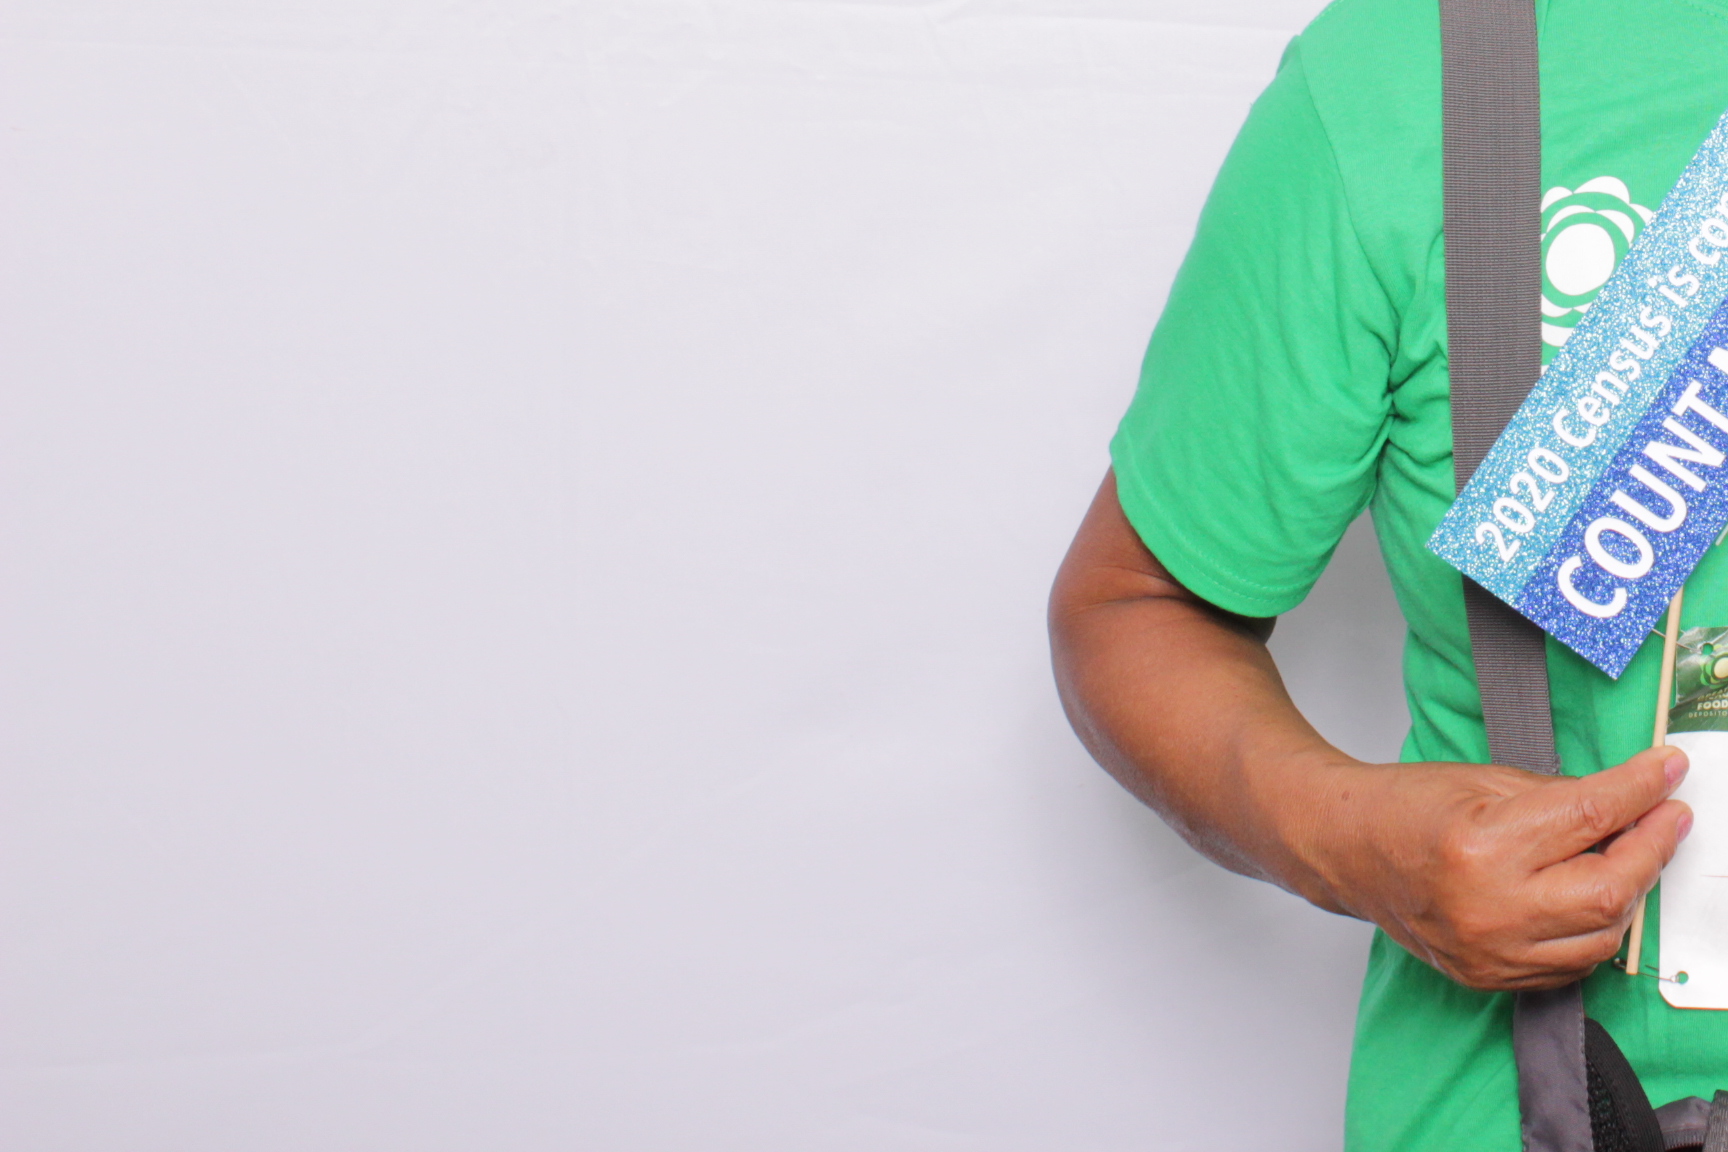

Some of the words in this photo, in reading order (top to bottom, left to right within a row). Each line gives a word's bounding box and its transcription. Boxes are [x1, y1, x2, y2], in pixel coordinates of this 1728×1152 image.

[1475, 447, 1570, 562] 2020
[1552, 301, 1671, 448] Census
[1649, 264, 1700, 308] is
[1697, 699, 1728, 710] FOOD
